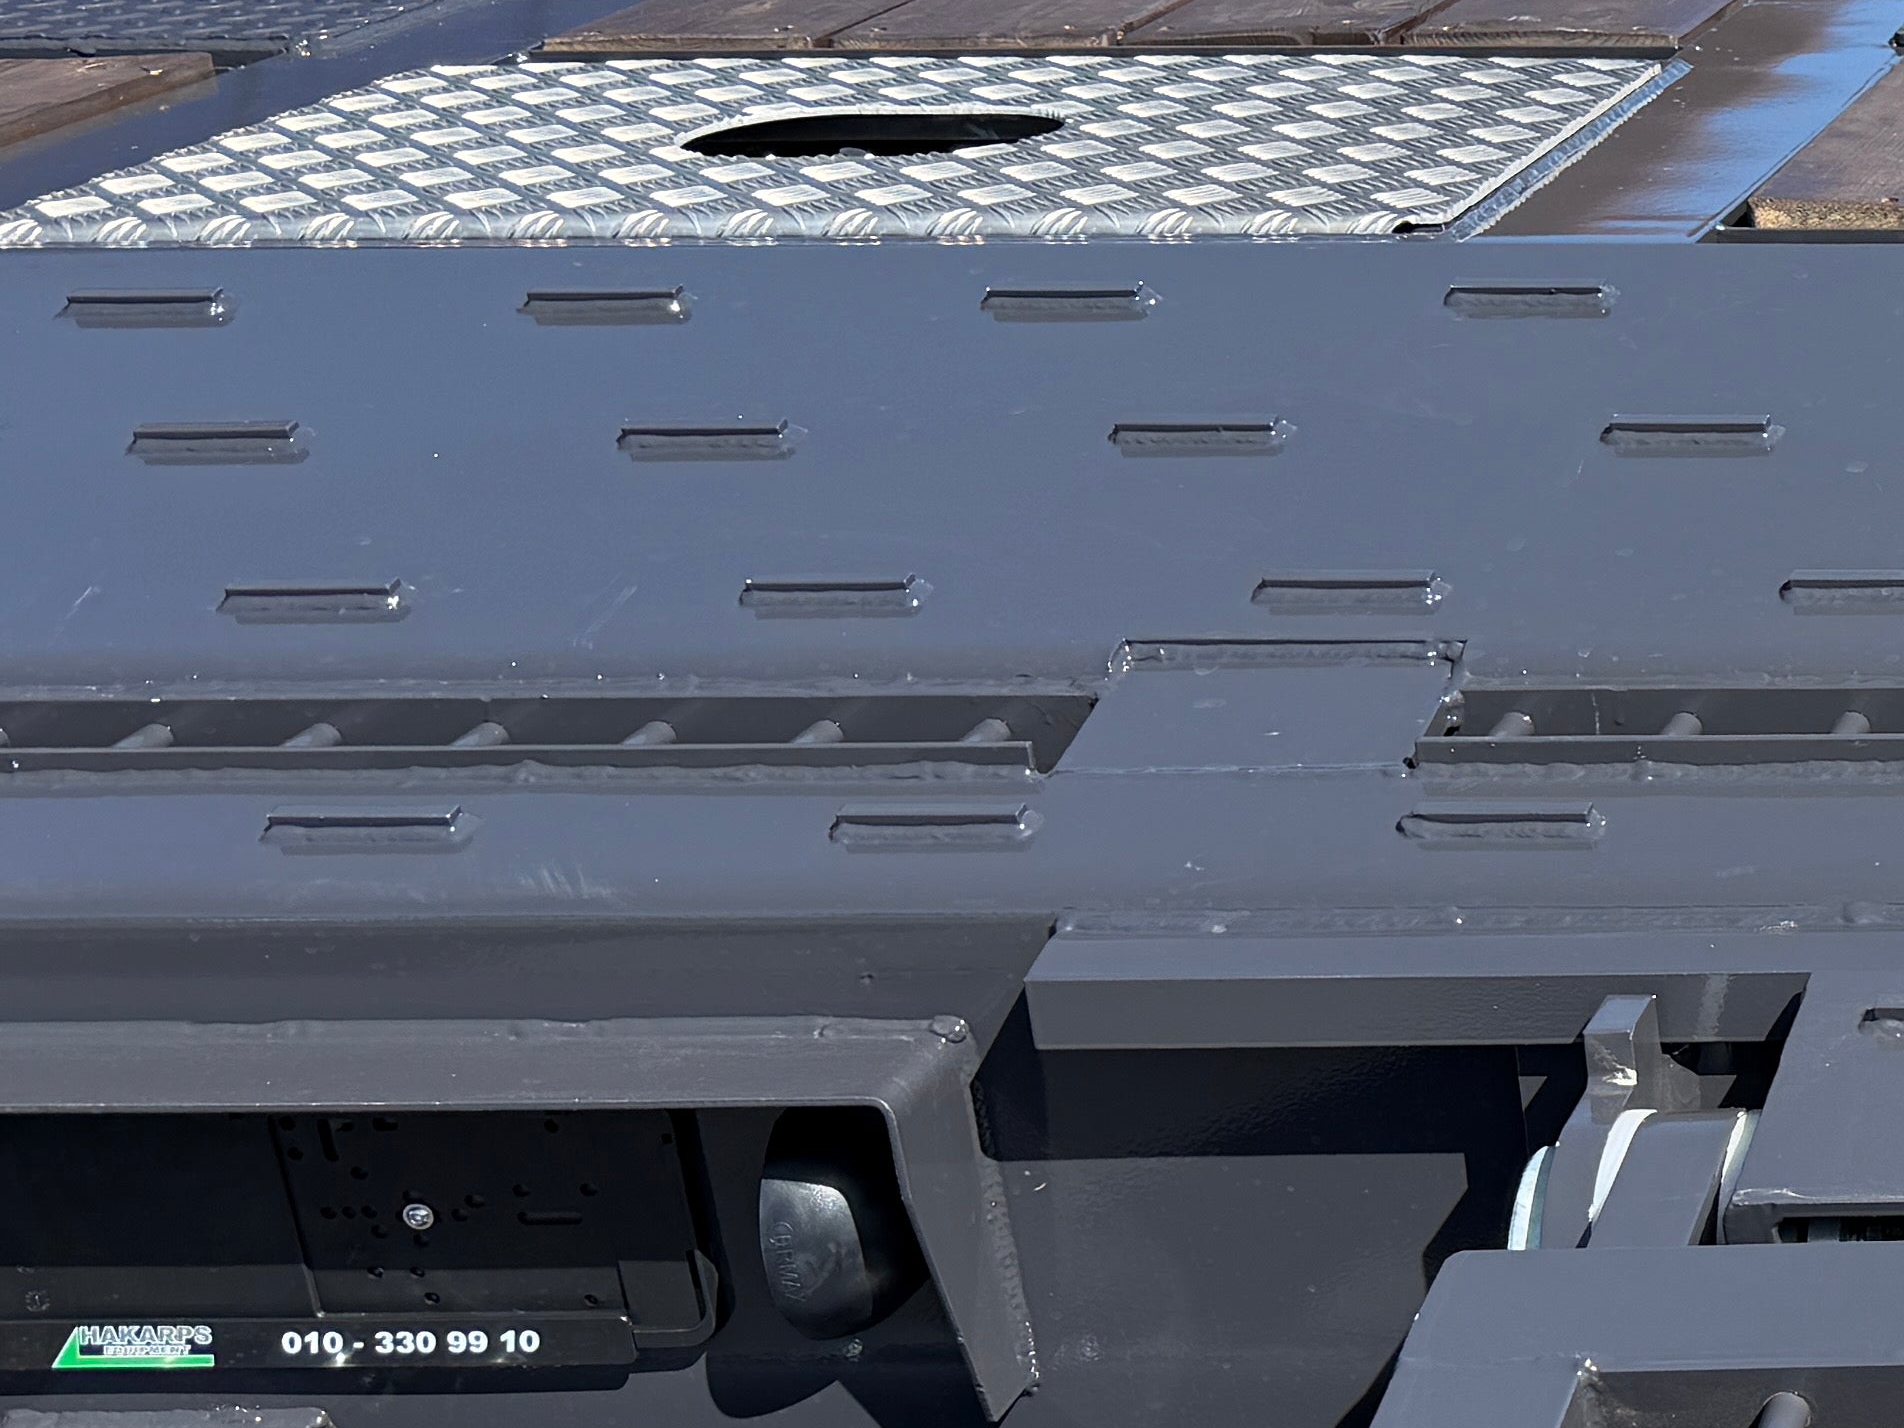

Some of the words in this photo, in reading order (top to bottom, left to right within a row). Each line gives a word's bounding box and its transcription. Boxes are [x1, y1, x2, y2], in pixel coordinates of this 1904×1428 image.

[79, 1325, 213, 1346] HAKARPS
[281, 1331, 344, 1355] 010
[374, 1331, 437, 1354] 330
[447, 1330, 489, 1354] 99
[500, 1329, 541, 1353] 10
